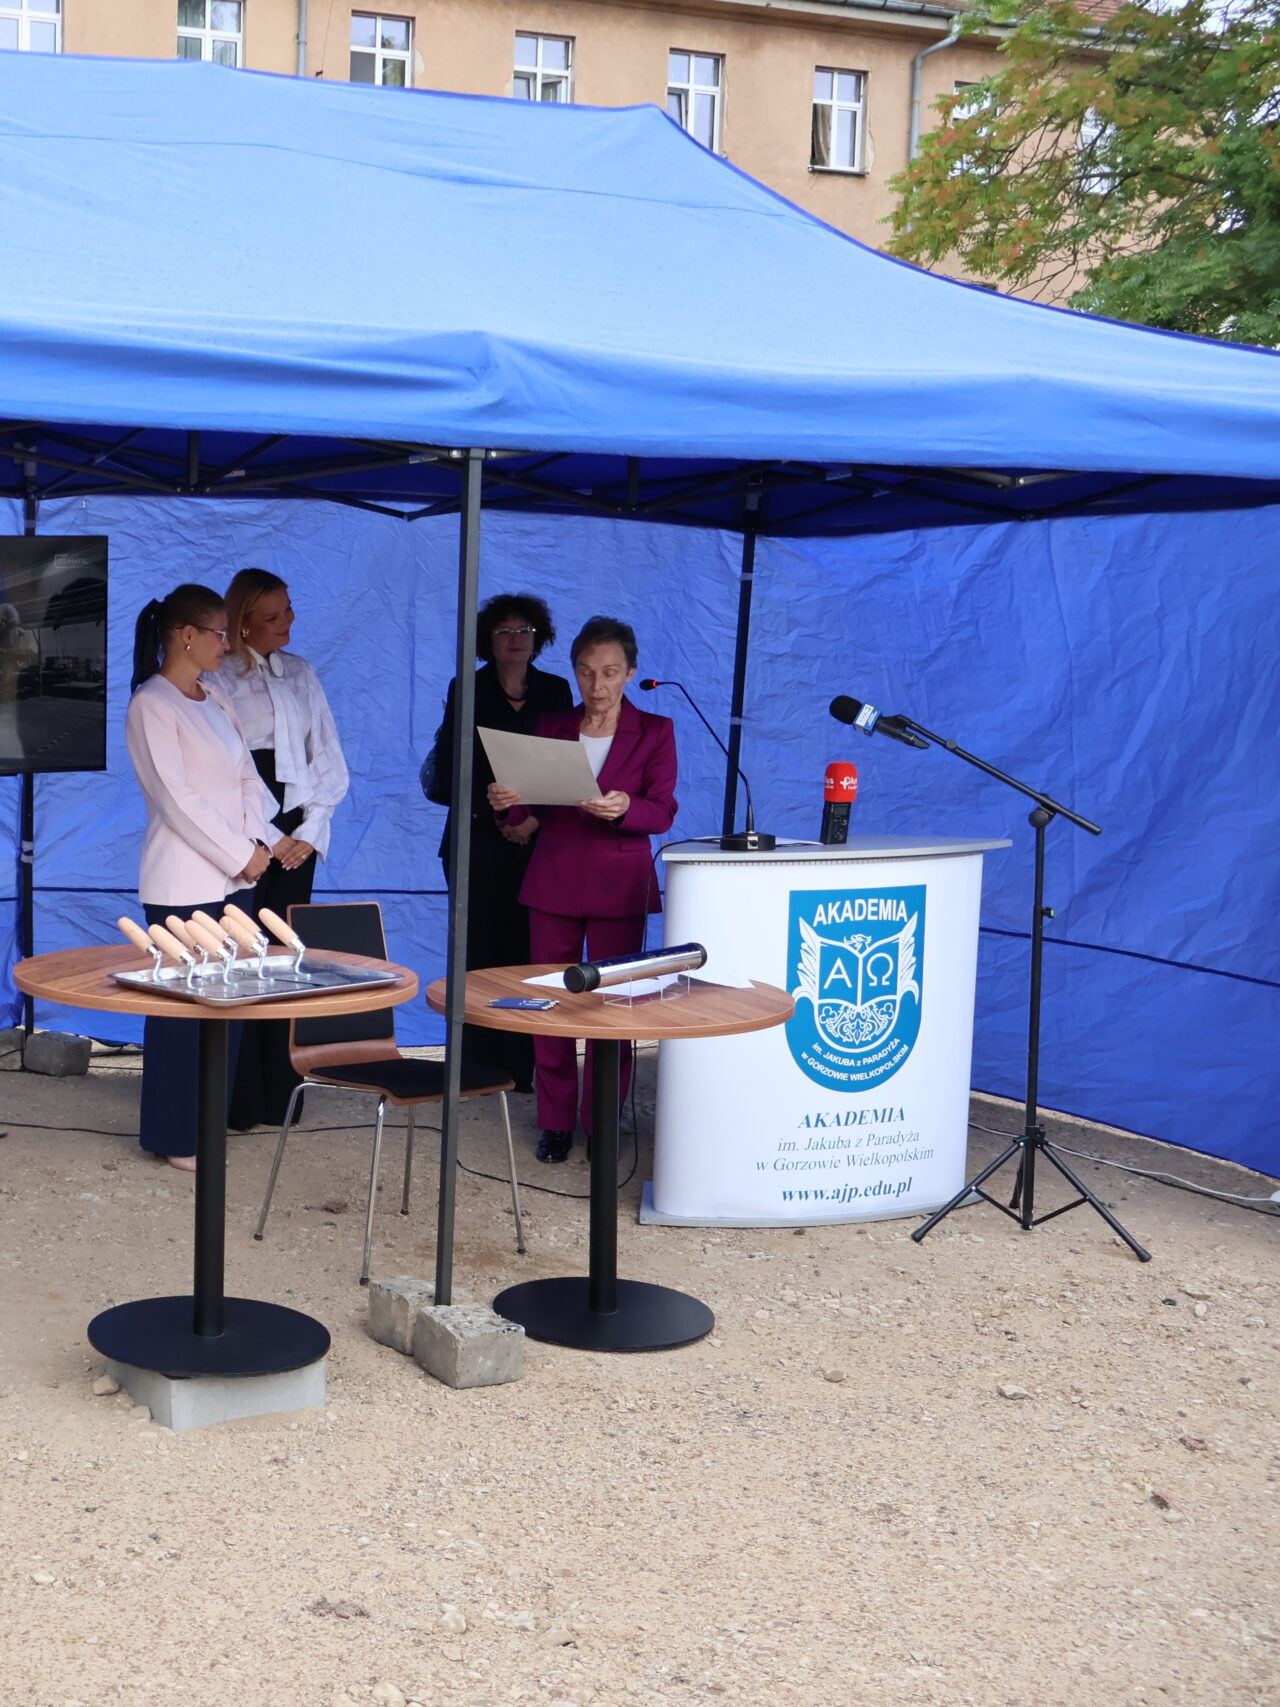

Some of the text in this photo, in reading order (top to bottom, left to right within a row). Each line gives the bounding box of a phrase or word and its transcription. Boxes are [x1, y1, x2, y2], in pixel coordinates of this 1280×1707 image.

[812, 898, 908, 927] AKADEMIA
[807, 1057, 849, 1081] GORZOWIE
[849, 1043, 910, 1081] WIELKOPOLSKIM
[823, 1051, 856, 1067] JAKUBA
[862, 1037, 901, 1066] PARADYŻA
[797, 1106, 906, 1130] AKADEMIA
[777, 1130, 921, 1152] im. Jakuba z Paradyża
[756, 1147, 935, 1172] w Gorzowie Wielkopolskim
[781, 1176, 913, 1204] www.ajp.edu.pl
